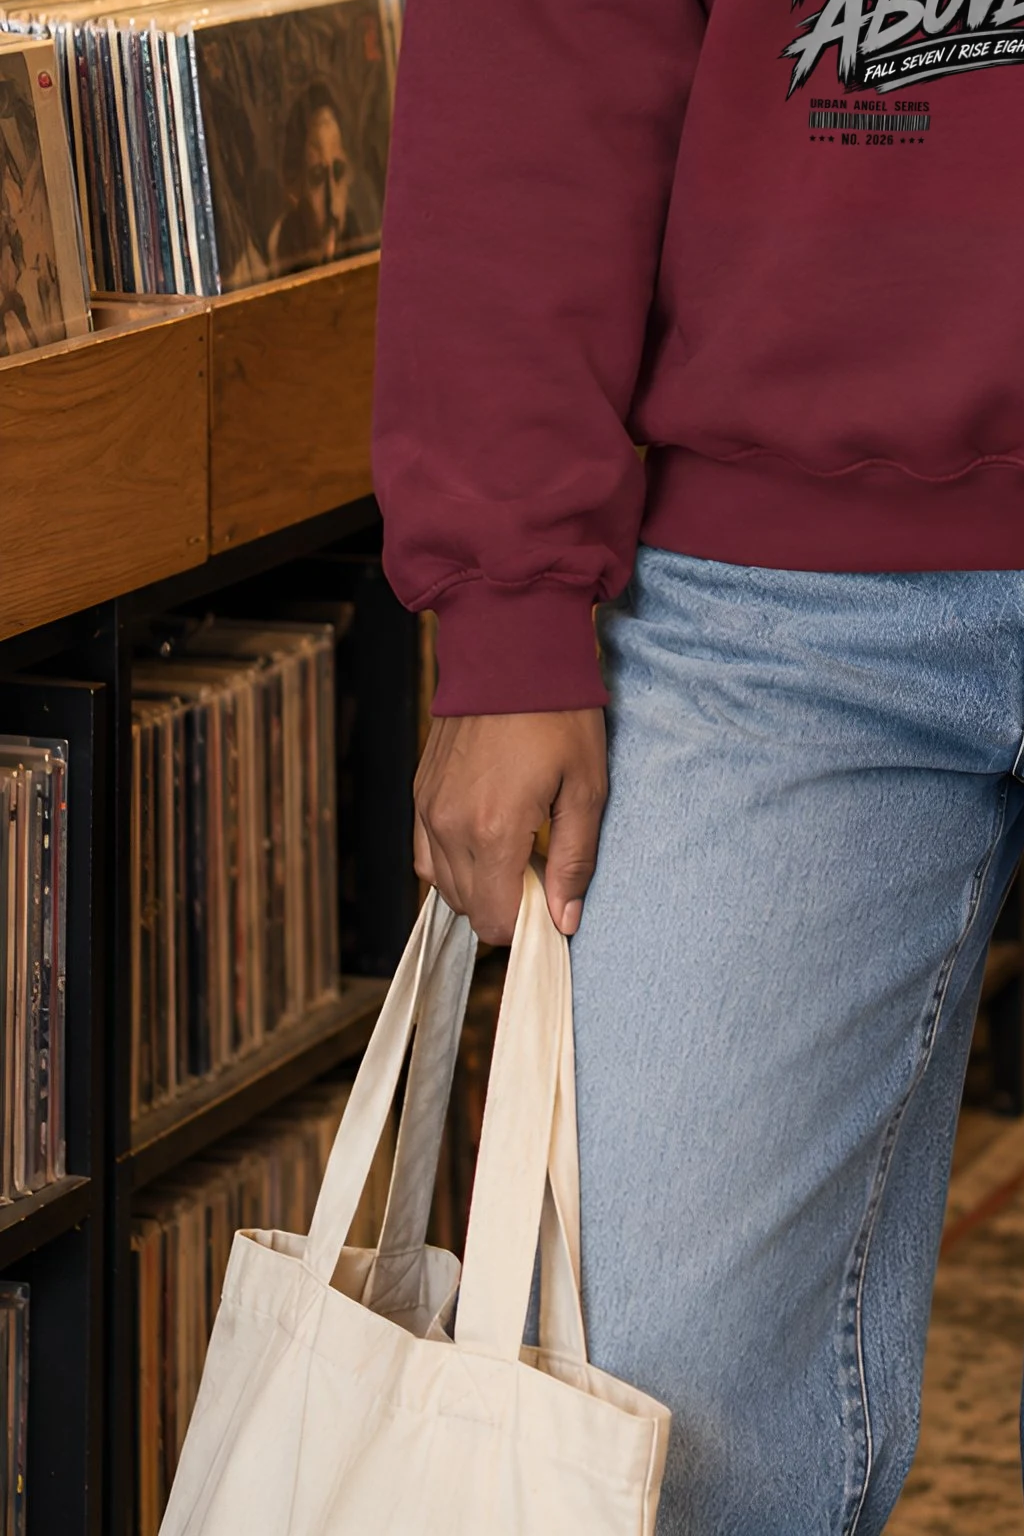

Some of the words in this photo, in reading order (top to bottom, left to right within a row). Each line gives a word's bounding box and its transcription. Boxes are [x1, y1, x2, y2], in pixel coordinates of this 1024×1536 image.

[864, 66, 896, 83] FALL
[901, 49, 946, 72] SEVEN
[958, 41, 991, 60] RISE
[810, 98, 847, 109] URBAN
[853, 100, 887, 111] ANGEL
[894, 101, 930, 112] SERIES
[841, 133, 859, 145] NO.
[866, 134, 894, 145] 2026
